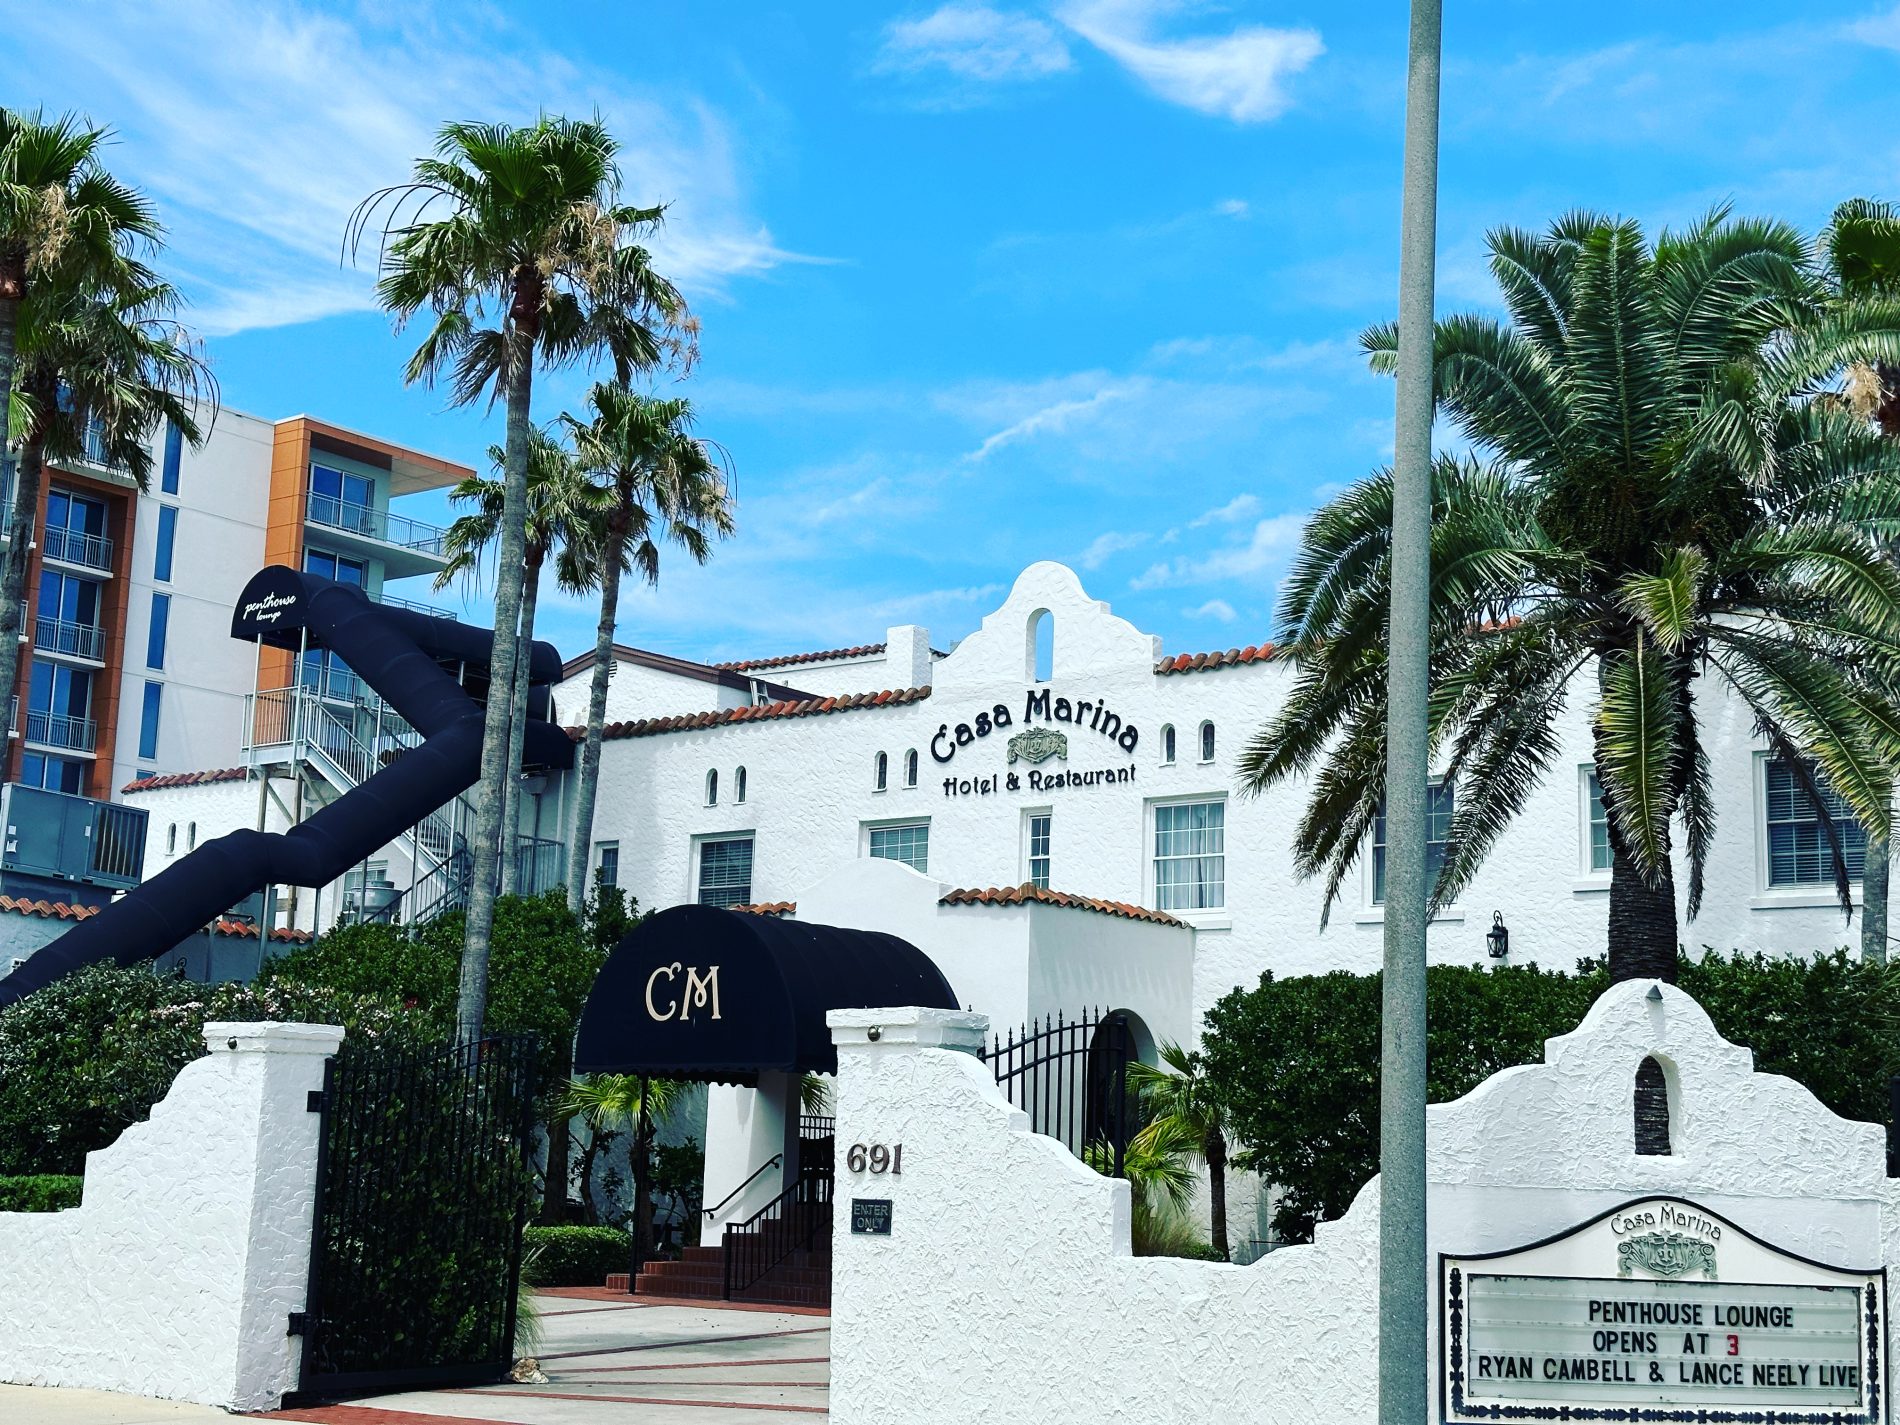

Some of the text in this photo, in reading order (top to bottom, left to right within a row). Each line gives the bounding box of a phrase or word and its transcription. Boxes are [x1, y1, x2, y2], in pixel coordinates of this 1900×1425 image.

[243, 591, 296, 620] penthouse
[256, 609, 281, 623] lounge
[930, 688, 1139, 763] Casa Marina
[943, 763, 1136, 796] Hotel & Restaurant
[645, 961, 722, 1021] CM
[847, 1143, 902, 1175] 691
[853, 1204, 888, 1216] ENTER
[856, 1217, 885, 1228] ONLY
[1611, 1204, 1721, 1240] Casa Marina
[1589, 1300, 1793, 1327] PENTHOUSE LOUNGE
[1593, 1331, 1739, 1356] OPENS AT 3
[1479, 1355, 1857, 1387] RYAN CAMBELL & LANCE NEELY LIVE
